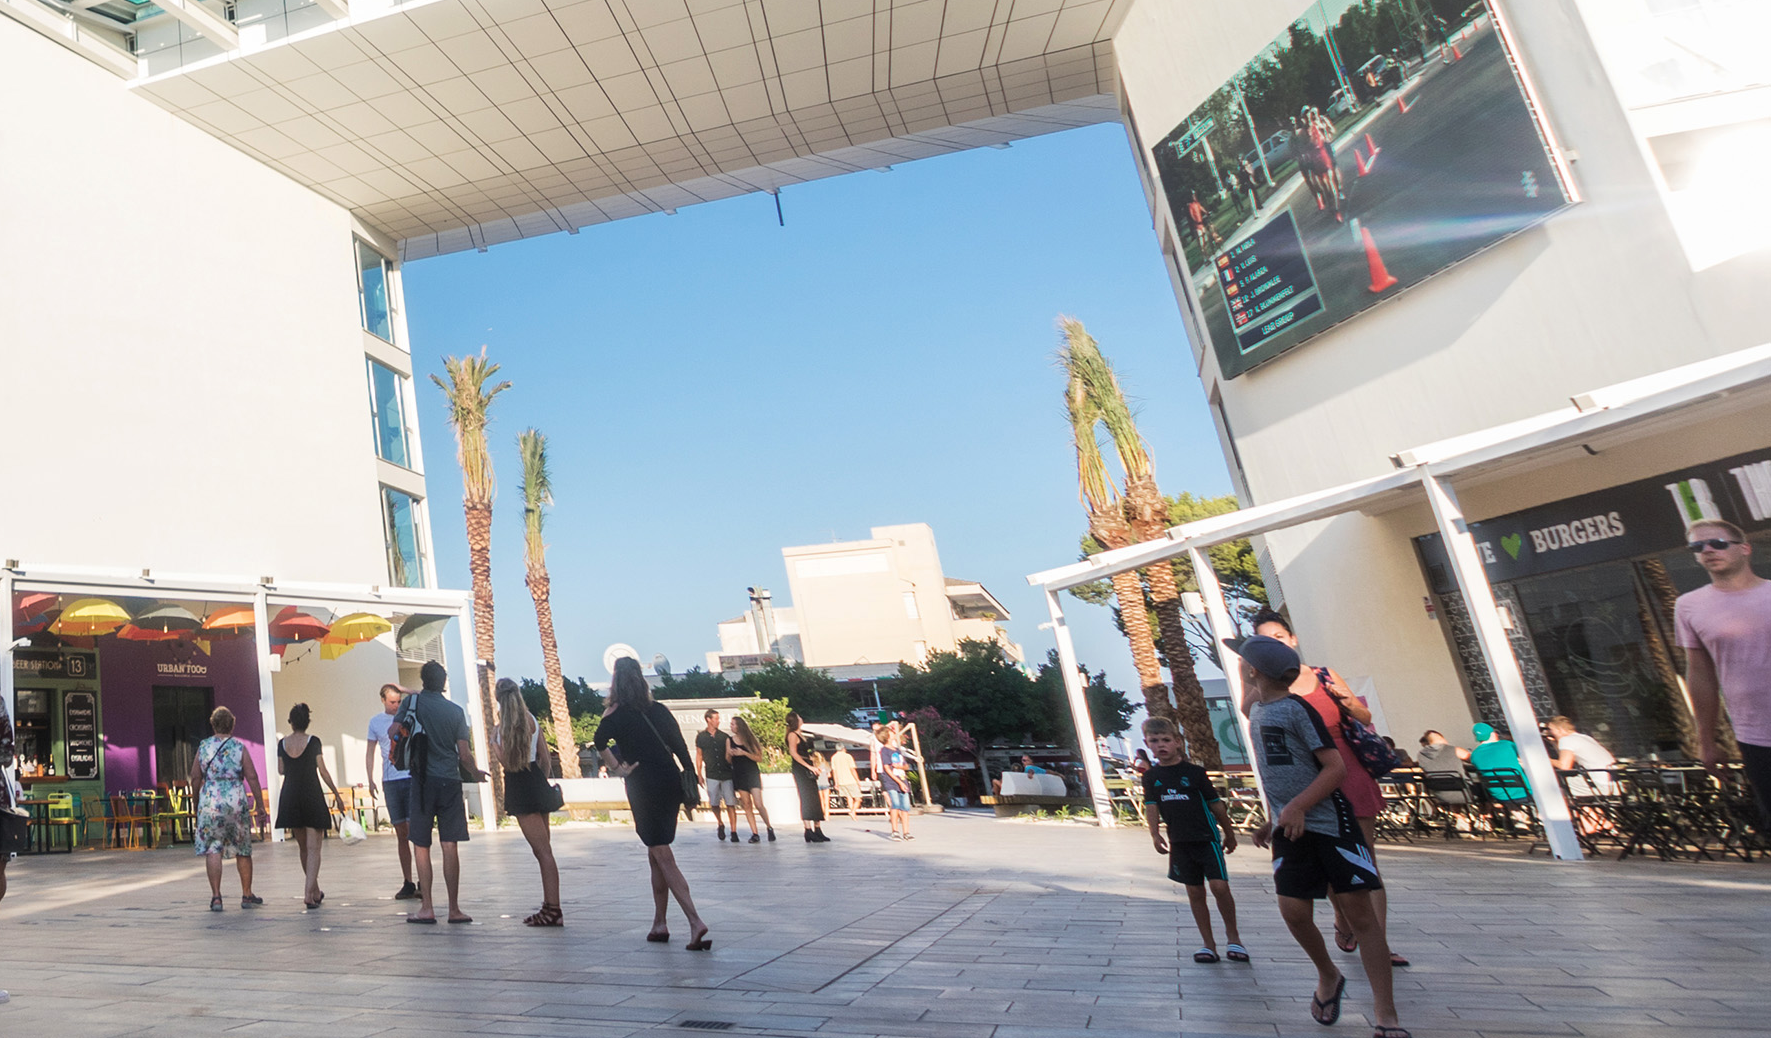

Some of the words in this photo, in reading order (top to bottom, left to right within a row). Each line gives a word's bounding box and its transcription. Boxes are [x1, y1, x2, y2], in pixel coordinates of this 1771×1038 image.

[1530, 511, 1626, 553] BURGERS
[71, 659, 83, 674] 13
[157, 663, 185, 673] URBAN
[187, 664, 207, 674] FOOD
[1160, 793, 1190, 802] Emirates
